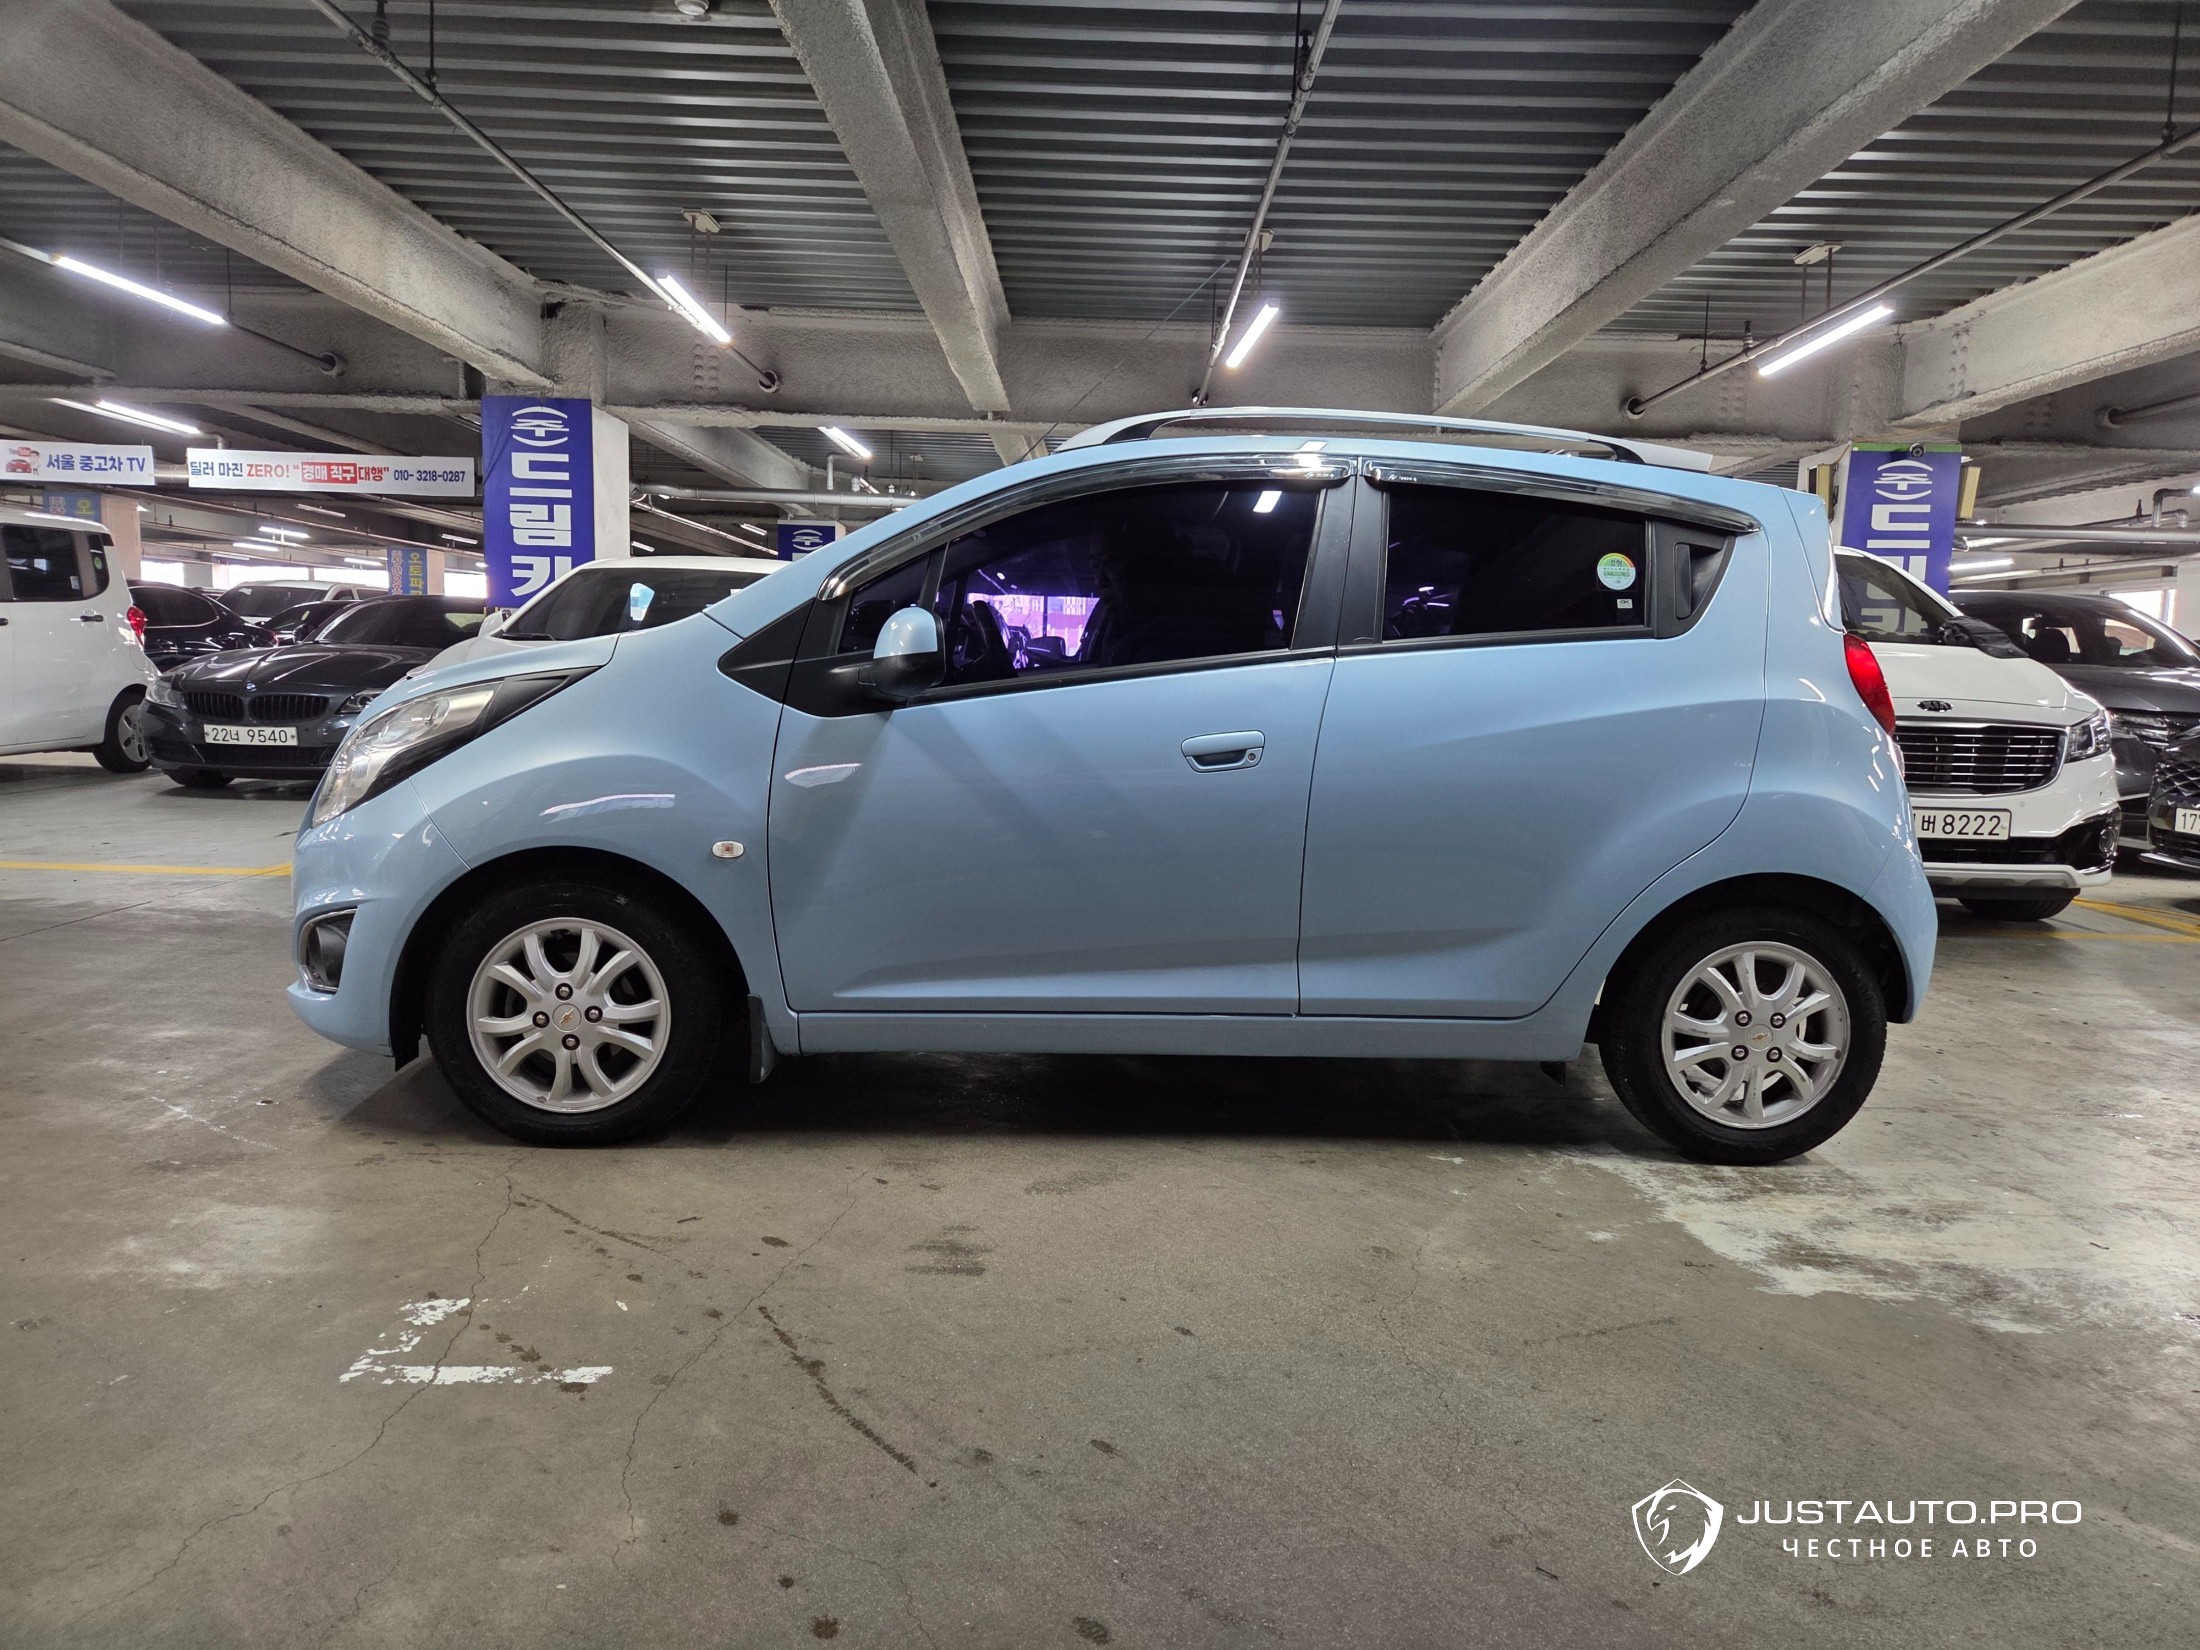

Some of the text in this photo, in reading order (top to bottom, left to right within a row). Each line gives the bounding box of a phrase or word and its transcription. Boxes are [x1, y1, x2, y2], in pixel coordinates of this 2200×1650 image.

[46, 454, 146, 472] 서울 중고차 TV
[190, 461, 215, 476] 딜러
[218, 462, 243, 477] 마진
[246, 463, 290, 478] ZERO!
[330, 465, 355, 481] 직구
[211, 728, 288, 743] 22너 9540
[1914, 813, 2001, 836] 버 8222
[2182, 812, 2200, 832] 17
